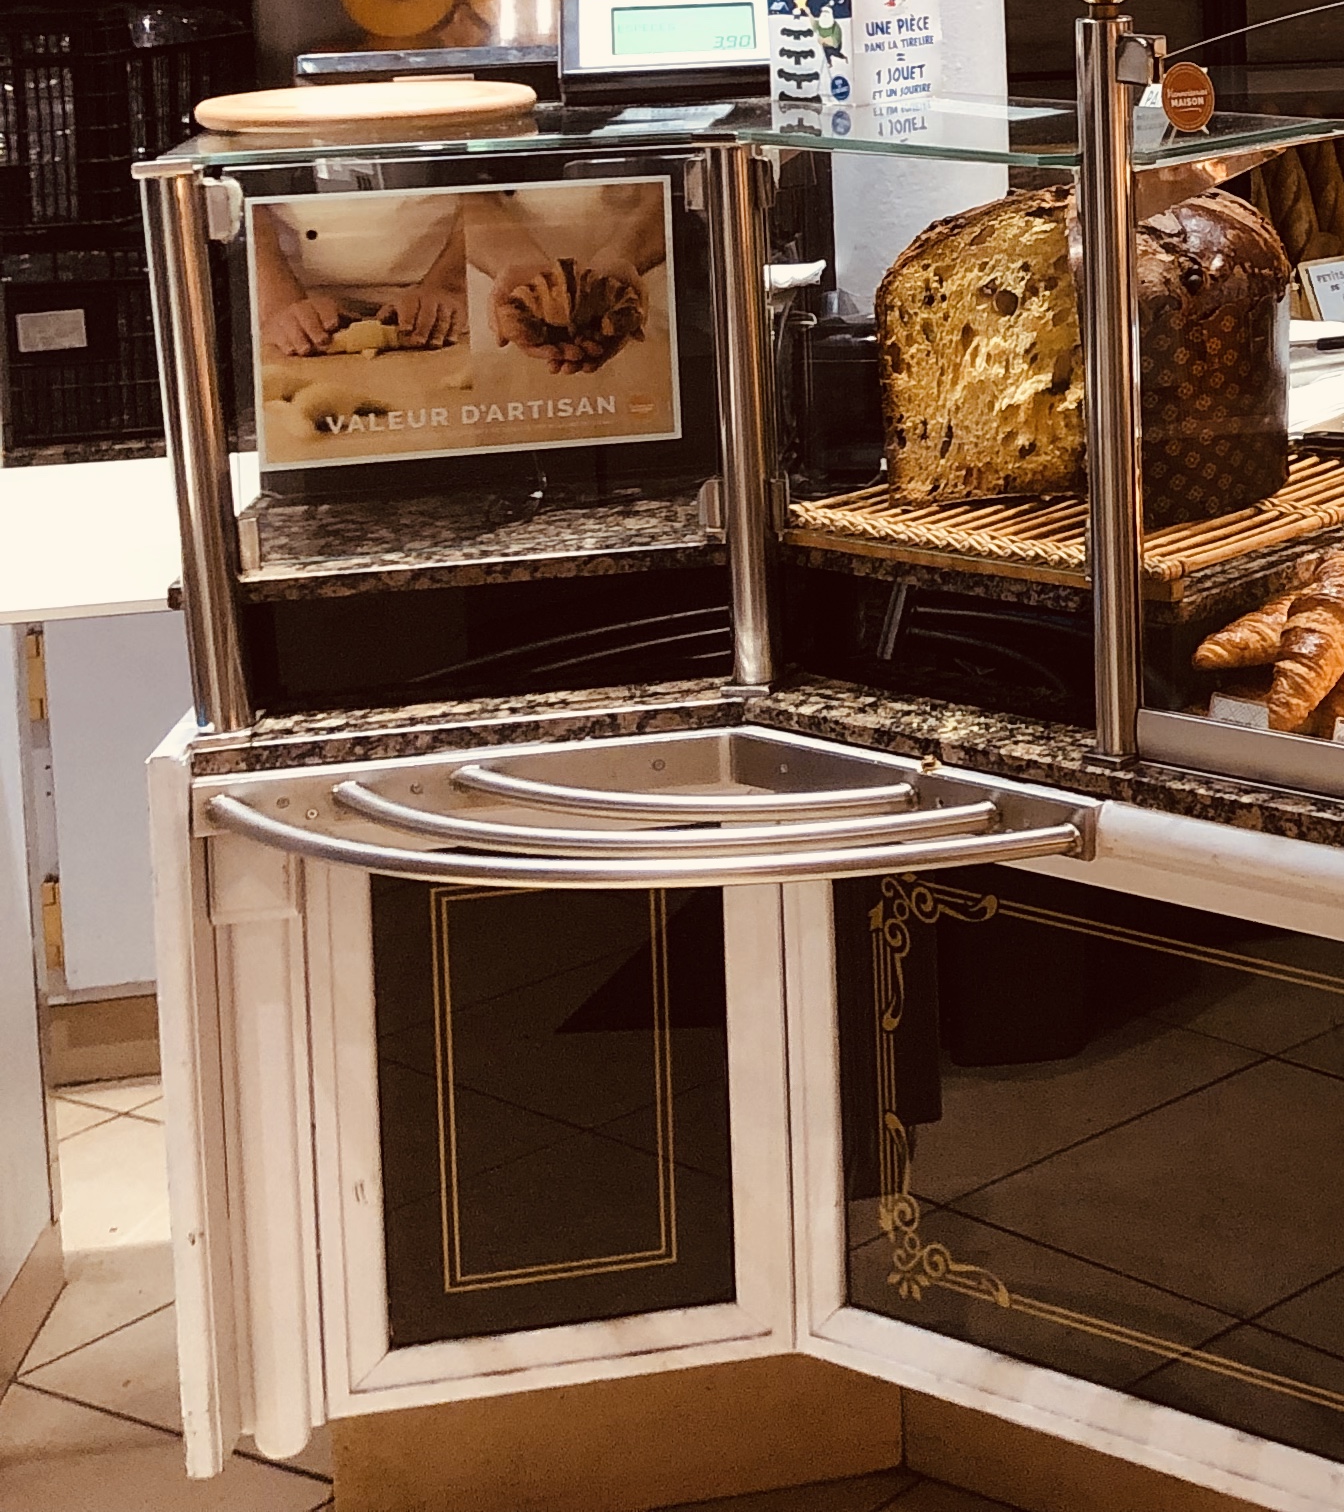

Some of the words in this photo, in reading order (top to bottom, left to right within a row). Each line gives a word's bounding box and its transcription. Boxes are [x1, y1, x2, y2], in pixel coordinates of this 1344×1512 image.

[866, 20, 893, 36] UNE
[897, 15, 930, 34] PIÈCE
[864, 40, 885, 53] DANS
[888, 39, 899, 50] LA
[900, 35, 934, 50] TIRELIRE
[875, 70, 882, 85] 1
[887, 64, 926, 85] JOUET
[873, 90, 885, 101] ET
[887, 88, 898, 99] UN
[900, 83, 931, 97] SOURIRE
[1316, 269, 1344, 283] PETITS
[1330, 284, 1341, 292] DE
[327, 407, 449, 435] VALEUR
[461, 395, 616, 425] D'ARTISAN
